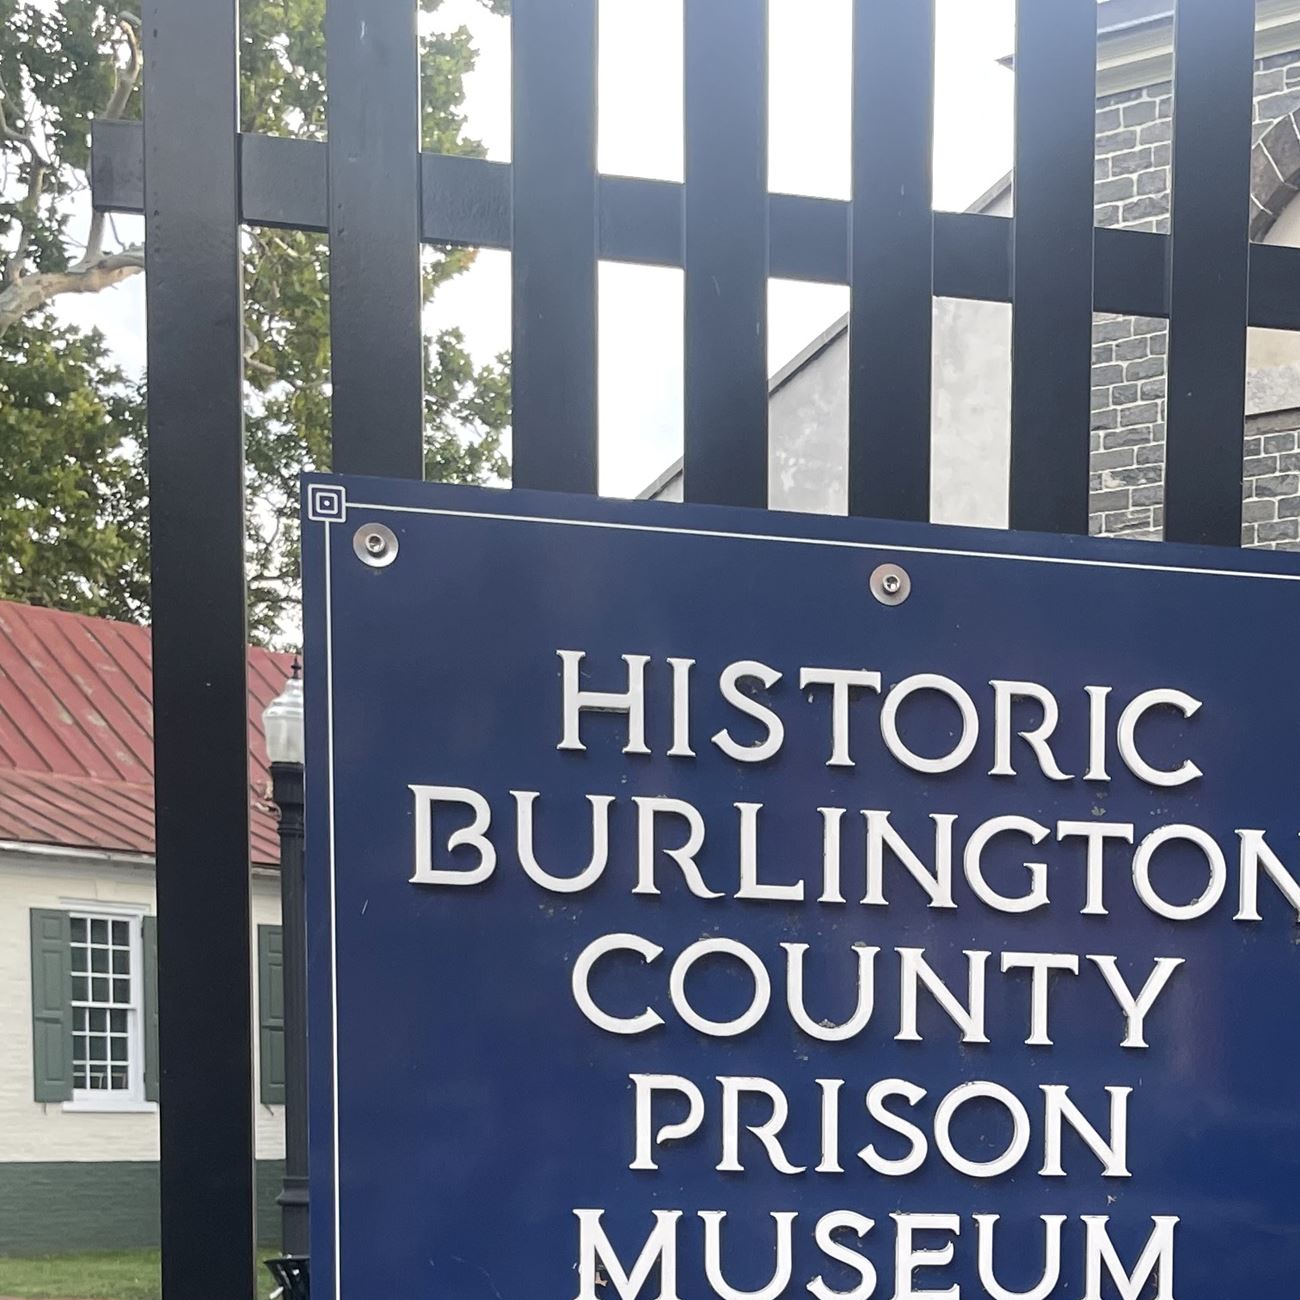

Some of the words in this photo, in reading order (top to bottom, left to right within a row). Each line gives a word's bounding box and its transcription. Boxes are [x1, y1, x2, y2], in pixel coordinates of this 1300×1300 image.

[556, 649, 1204, 787] HISTORIC
[571, 932, 1186, 1048] COUNTY
[628, 1073, 1134, 1178] PRISON
